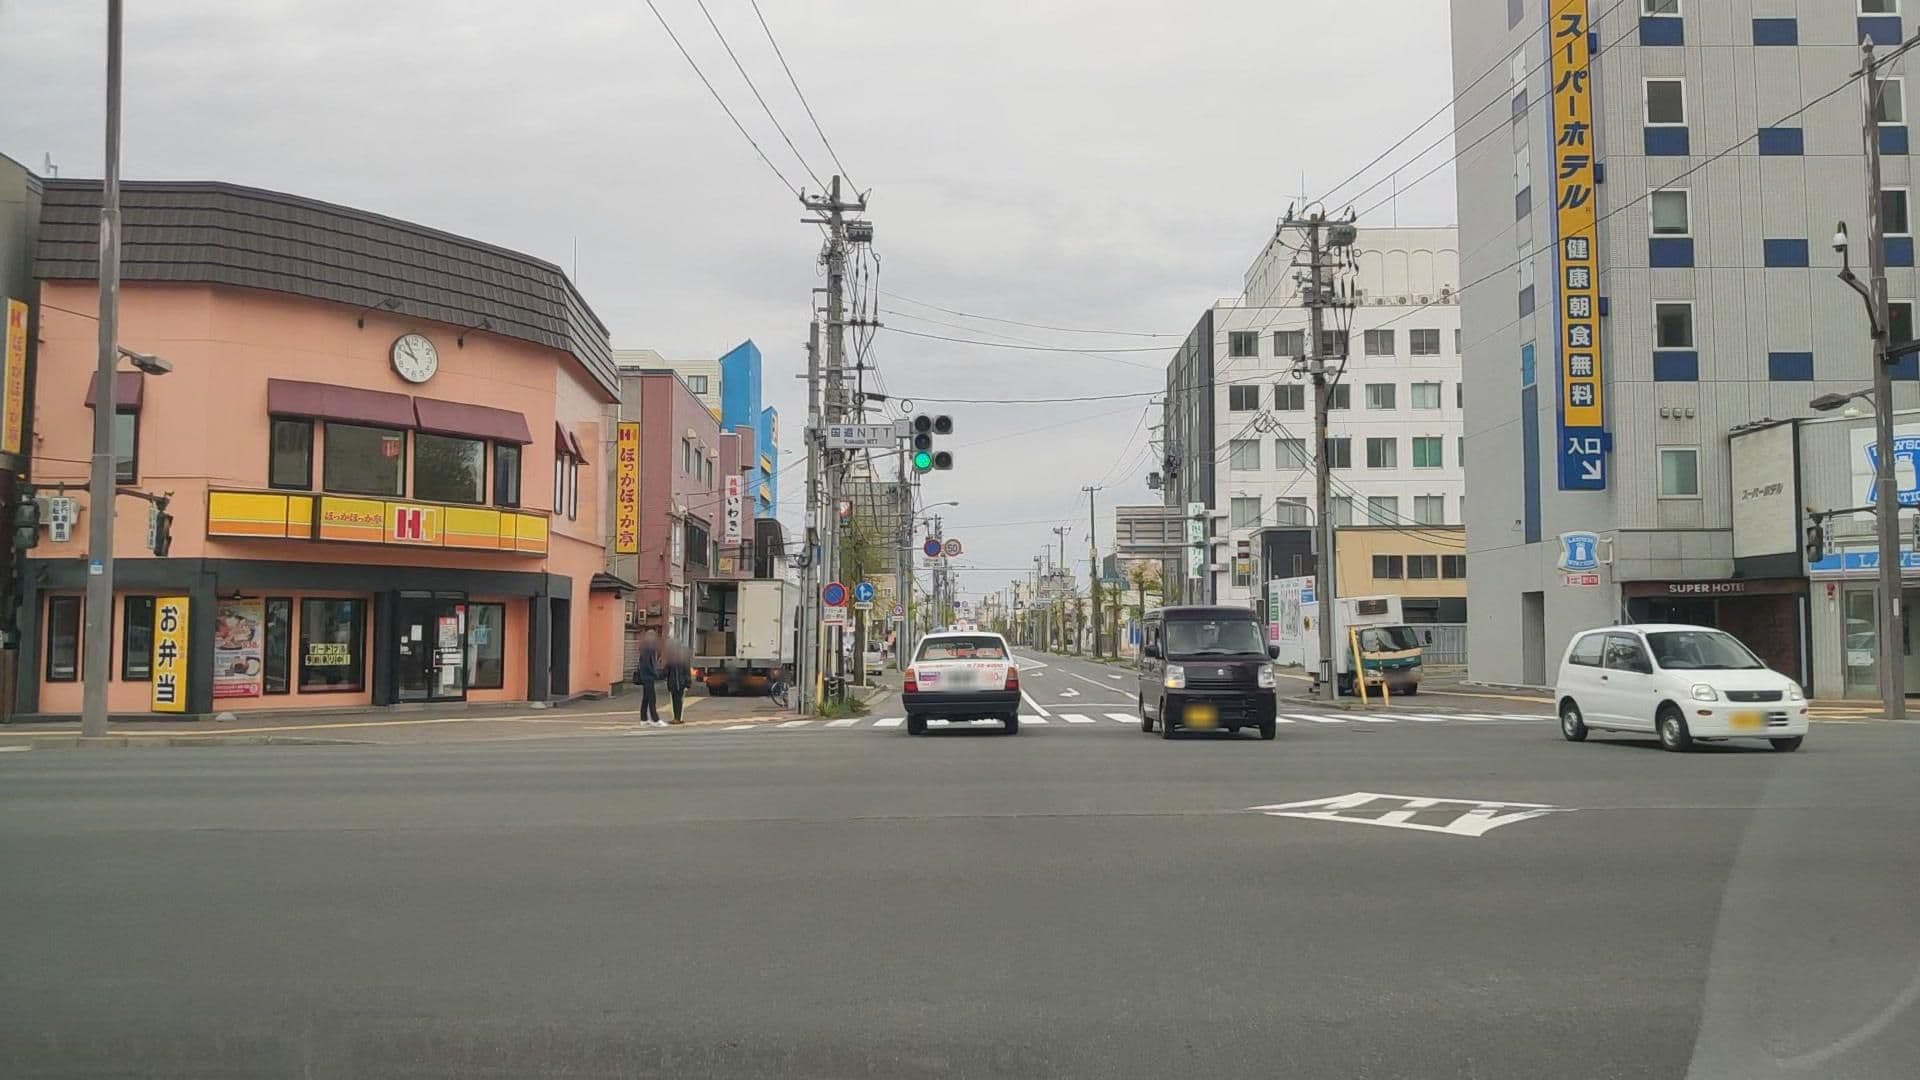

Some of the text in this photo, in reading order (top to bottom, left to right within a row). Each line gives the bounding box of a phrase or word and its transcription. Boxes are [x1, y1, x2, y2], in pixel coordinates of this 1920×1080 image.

[1556, 14, 1591, 210] スーパーホテル
[1565, 237, 1595, 407] 健康朝食無料
[1568, 438, 1600, 455] 入口
[619, 447, 635, 547] ほっかほっか亭
[1669, 584, 1710, 593] SUPER
[156, 605, 178, 703] お弁当
